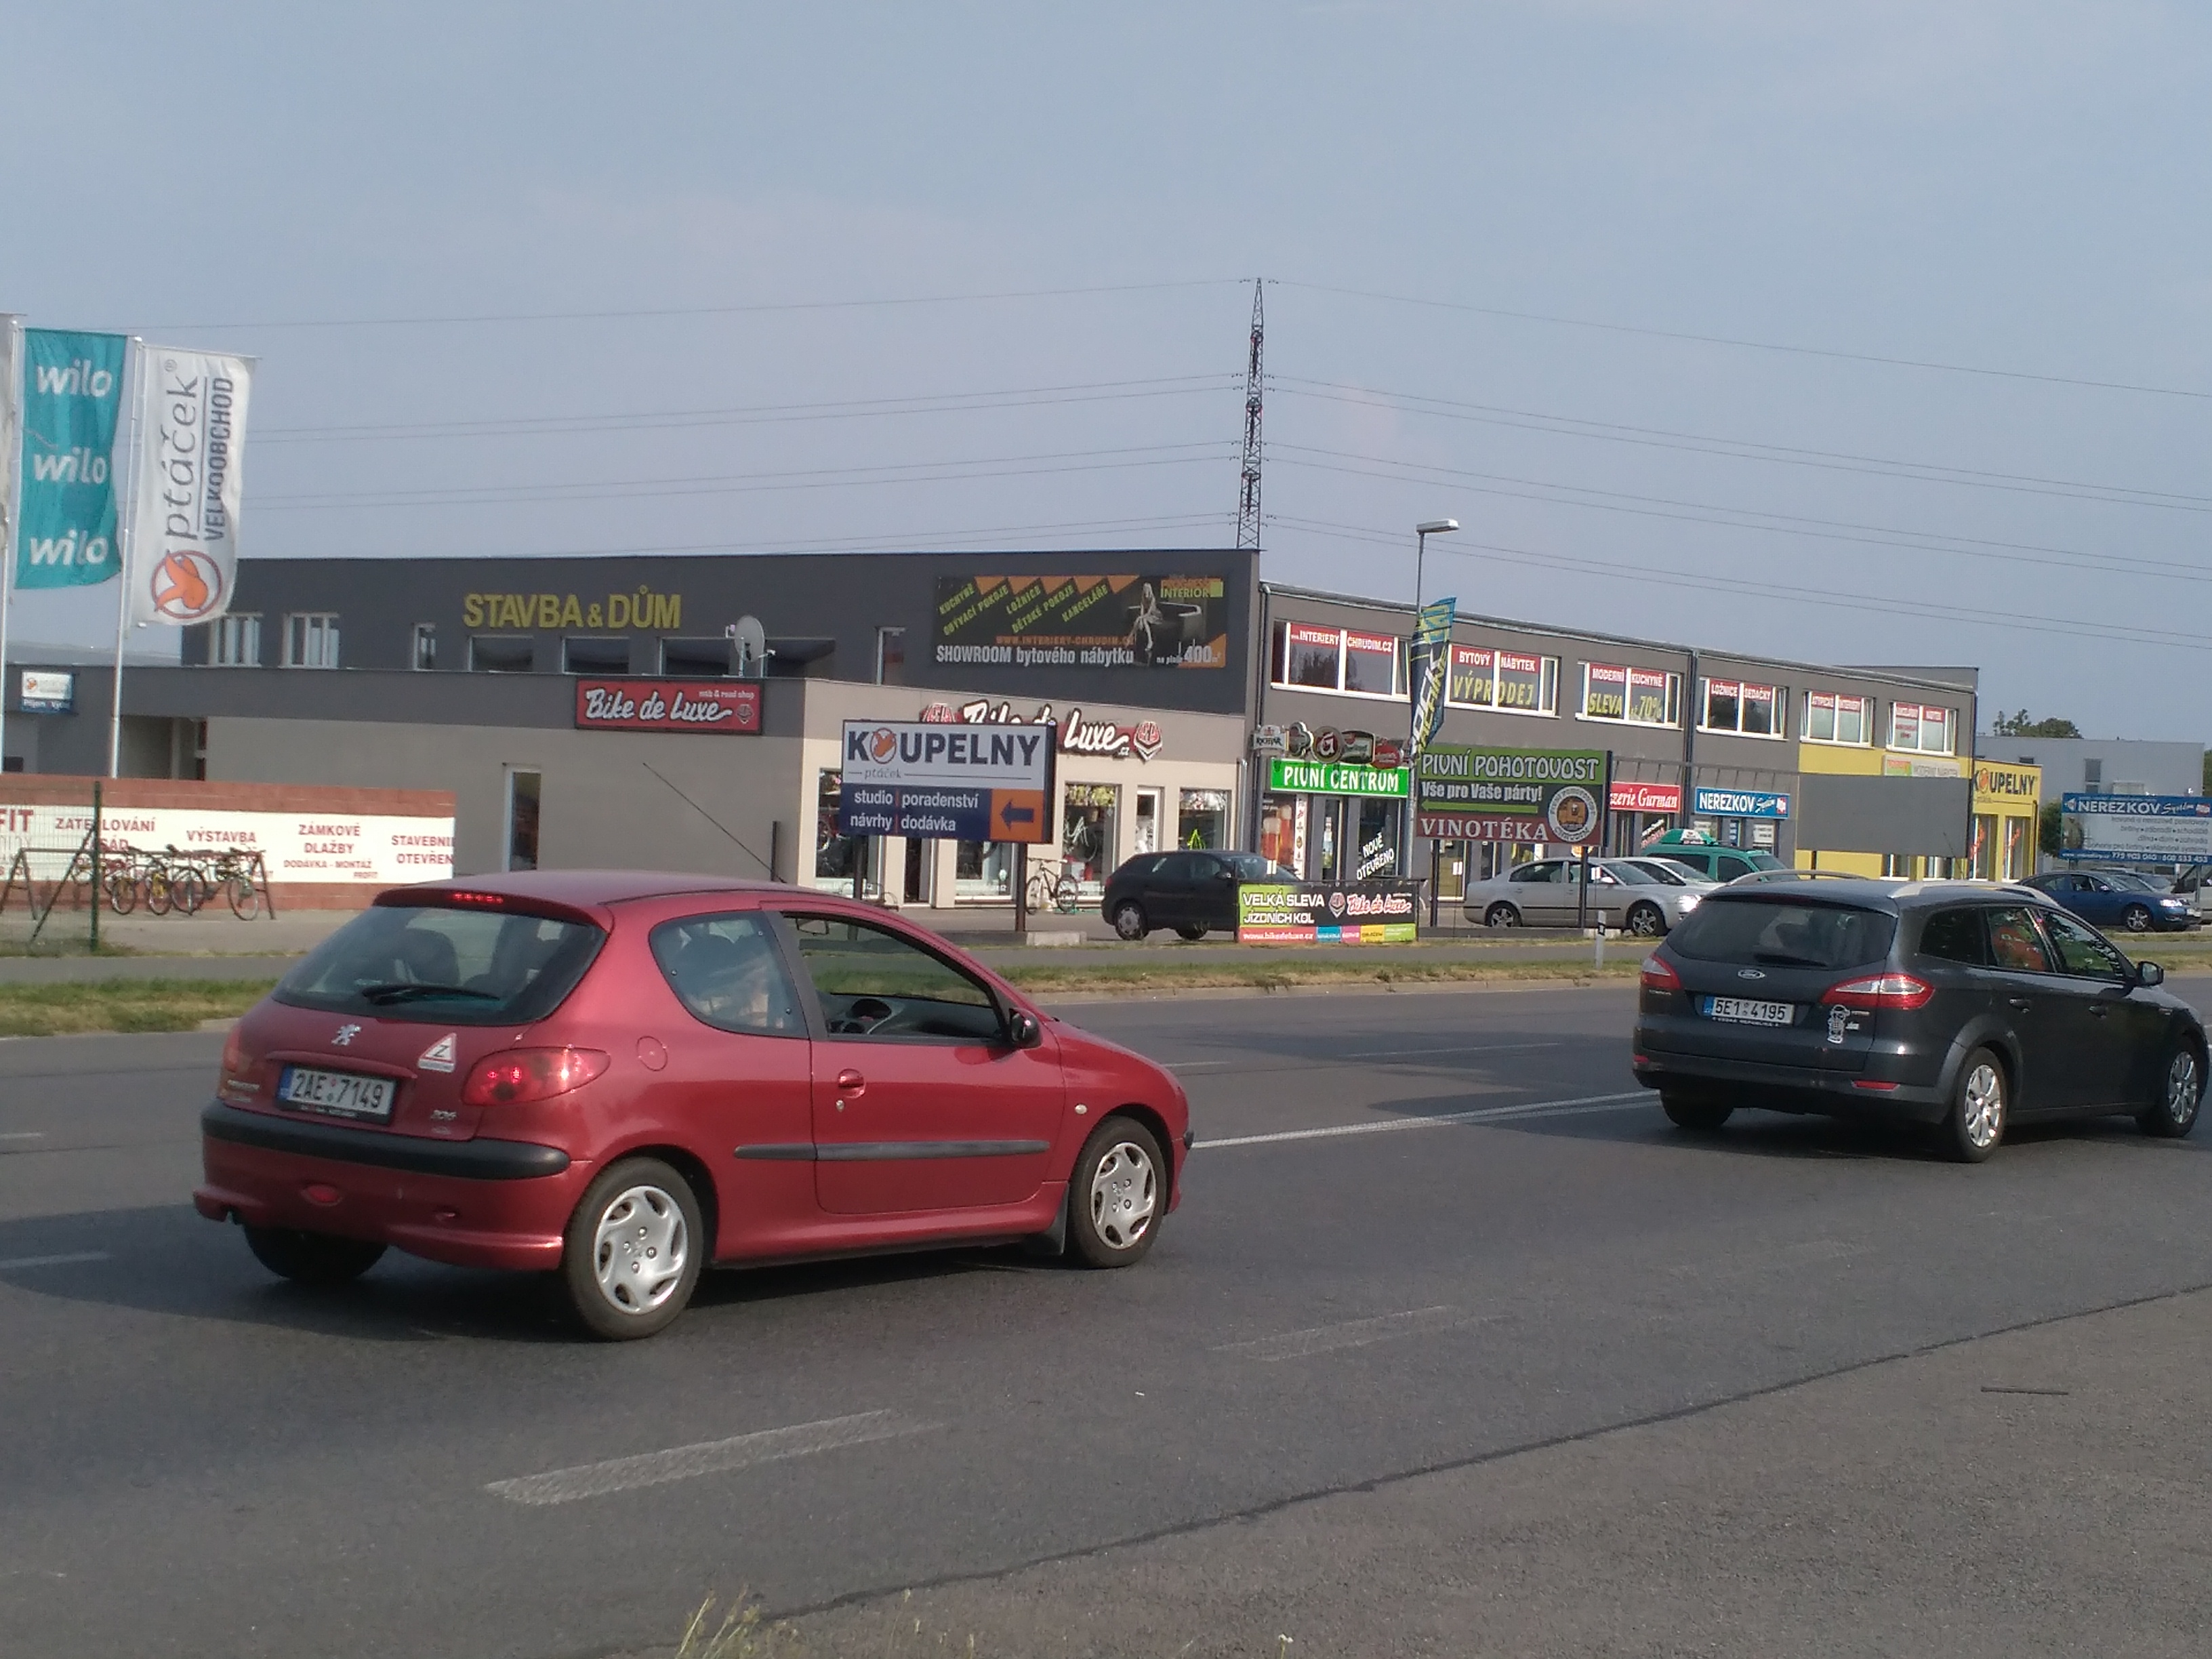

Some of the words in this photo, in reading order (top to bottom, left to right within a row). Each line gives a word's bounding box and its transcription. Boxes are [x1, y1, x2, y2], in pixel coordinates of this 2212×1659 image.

[36, 359, 112, 398] wilo
[33, 447, 108, 483] wilo
[161, 375, 199, 541] ptáček
[205, 377, 234, 542] VELKOOBCHOD
[29, 529, 108, 566] wilo
[462, 594, 584, 628] STAVBA
[608, 585, 682, 629] DŮM
[937, 645, 1012, 663] SHOWROOM
[1016, 646, 1075, 667] bytového
[1080, 646, 1134, 666] nábytku
[1185, 645, 1212, 663] 400
[1459, 651, 1491, 666] BYTOVÝ
[1500, 654, 1536, 672] NÁBYTEK
[1453, 669, 1534, 705] VÝPRODEJ
[586, 688, 635, 720] Bike
[639, 691, 666, 720] de
[670, 691, 733, 722] Luxe
[1588, 693, 1623, 714] SLEVA
[1063, 710, 1129, 750] Luxe
[1422, 749, 1472, 776] PIVNÍ
[1474, 755, 1599, 780] POHOTOVOST
[1284, 764, 1326, 786] PIVNÍ
[1330, 769, 1399, 792] CENTRUM
[855, 790, 893, 805] studio
[901, 793, 980, 808] poradenství
[1421, 781, 1445, 798] Vše
[1447, 785, 1469, 799] pro
[1471, 783, 1500, 800] Vaše
[1503, 784, 1543, 802] párty!
[1638, 788, 1677, 808] Gurman
[1700, 793, 1755, 812] NEREZKOV
[2078, 800, 2160, 813] NEREZKOV
[55, 816, 156, 832] ZATELOVÁNÍ
[299, 821, 361, 836] ZÁMKOVÉ
[851, 813, 893, 830] návrhy
[901, 815, 956, 832] dodávka
[1420, 817, 1549, 841] VINOTÉKA
[186, 826, 256, 842] VÝSTAVBA
[304, 840, 354, 853] DLAŽBY
[283, 859, 327, 868] DODÁVKA
[335, 858, 372, 868] MONTÁŽ
[1242, 888, 1285, 907] VELKÁ
[1286, 894, 1325, 907] SLEVA
[1244, 909, 1292, 924] JÍZDNÍCH
[1293, 912, 1315, 924] KOL
[1715, 1000, 1740, 1015] 5E1
[1751, 1004, 1786, 1021] 4195
[292, 1073, 327, 1101] 2AE
[336, 1079, 384, 1109] 7149
